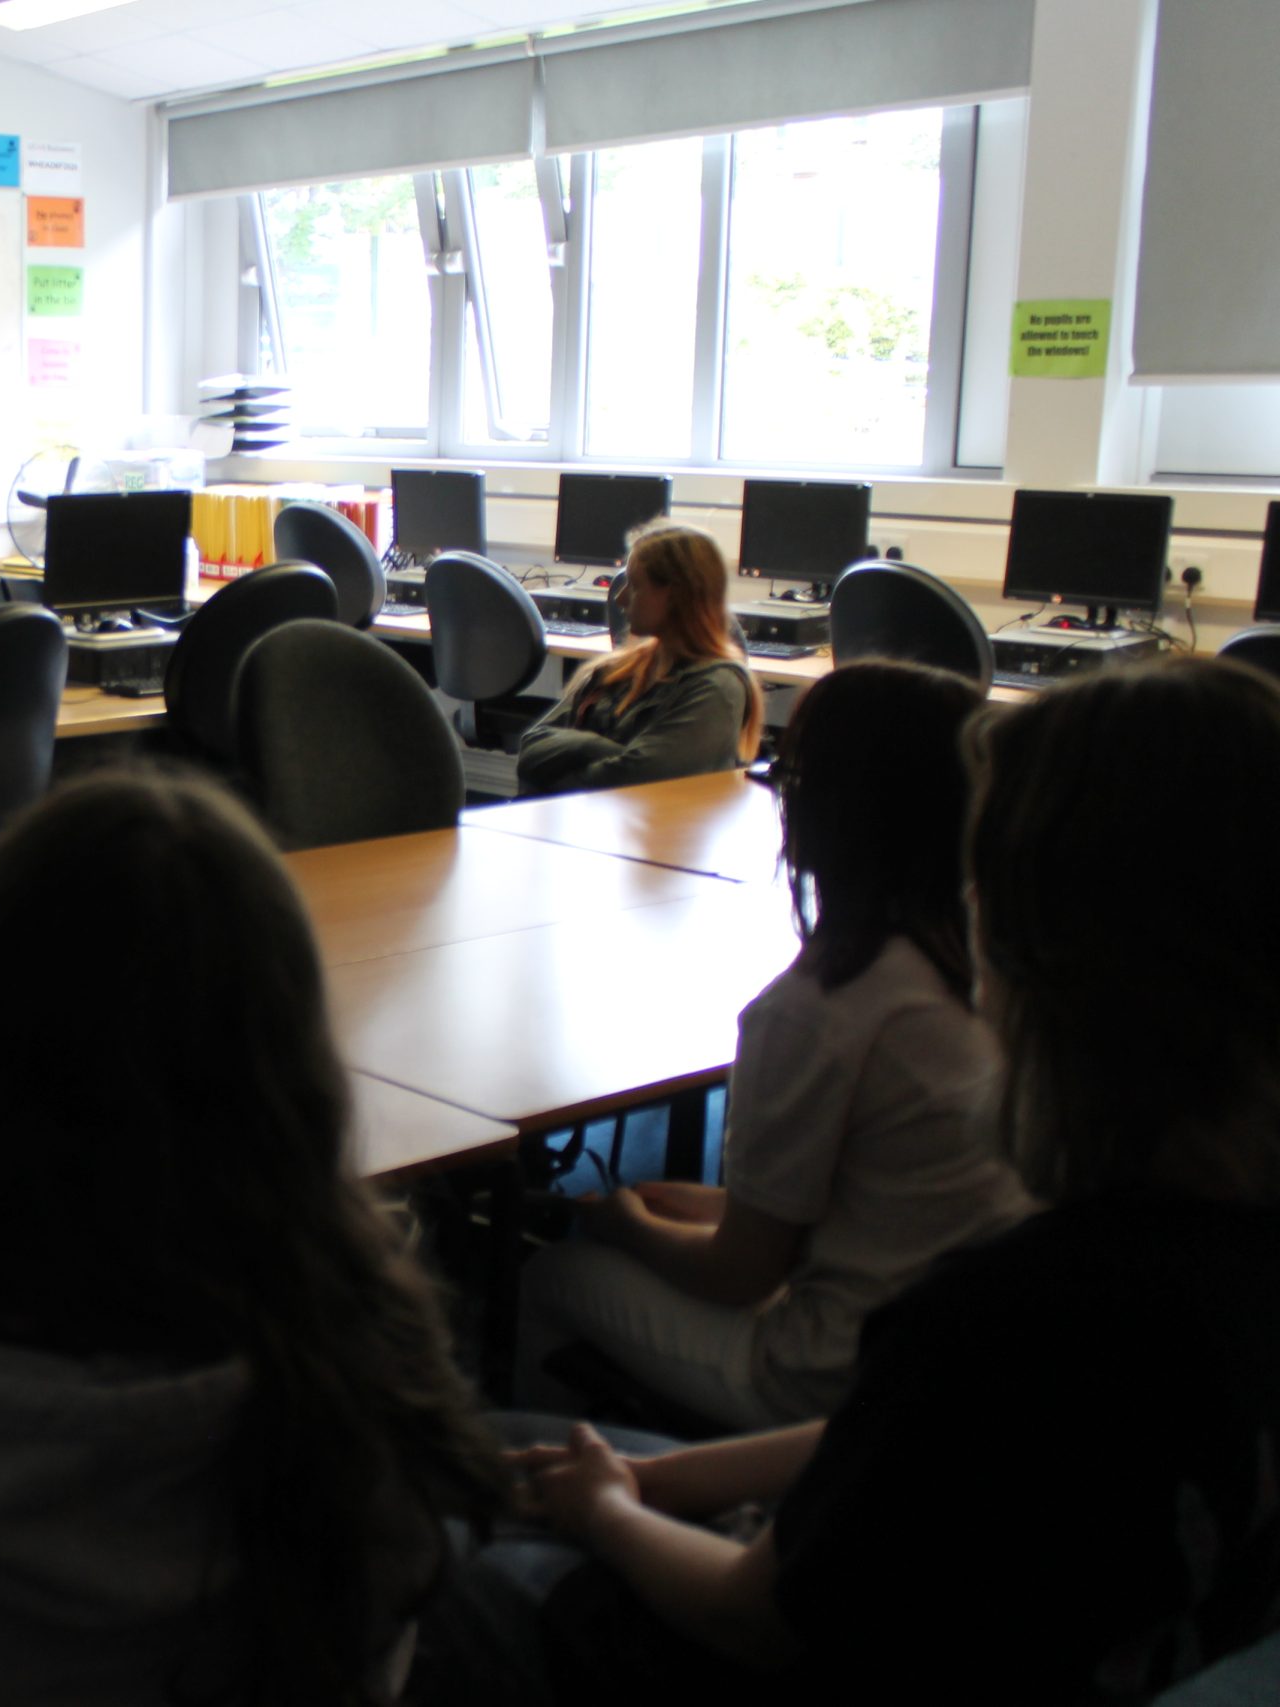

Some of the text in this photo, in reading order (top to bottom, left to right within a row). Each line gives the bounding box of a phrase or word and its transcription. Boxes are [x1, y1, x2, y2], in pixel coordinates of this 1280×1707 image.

[34, 276, 49, 288] Put
[46, 294, 60, 304] the
[1030, 313, 1091, 326] No pupils are
[1021, 329, 1098, 341] allowed to touch
[1028, 346, 1042, 357] the
